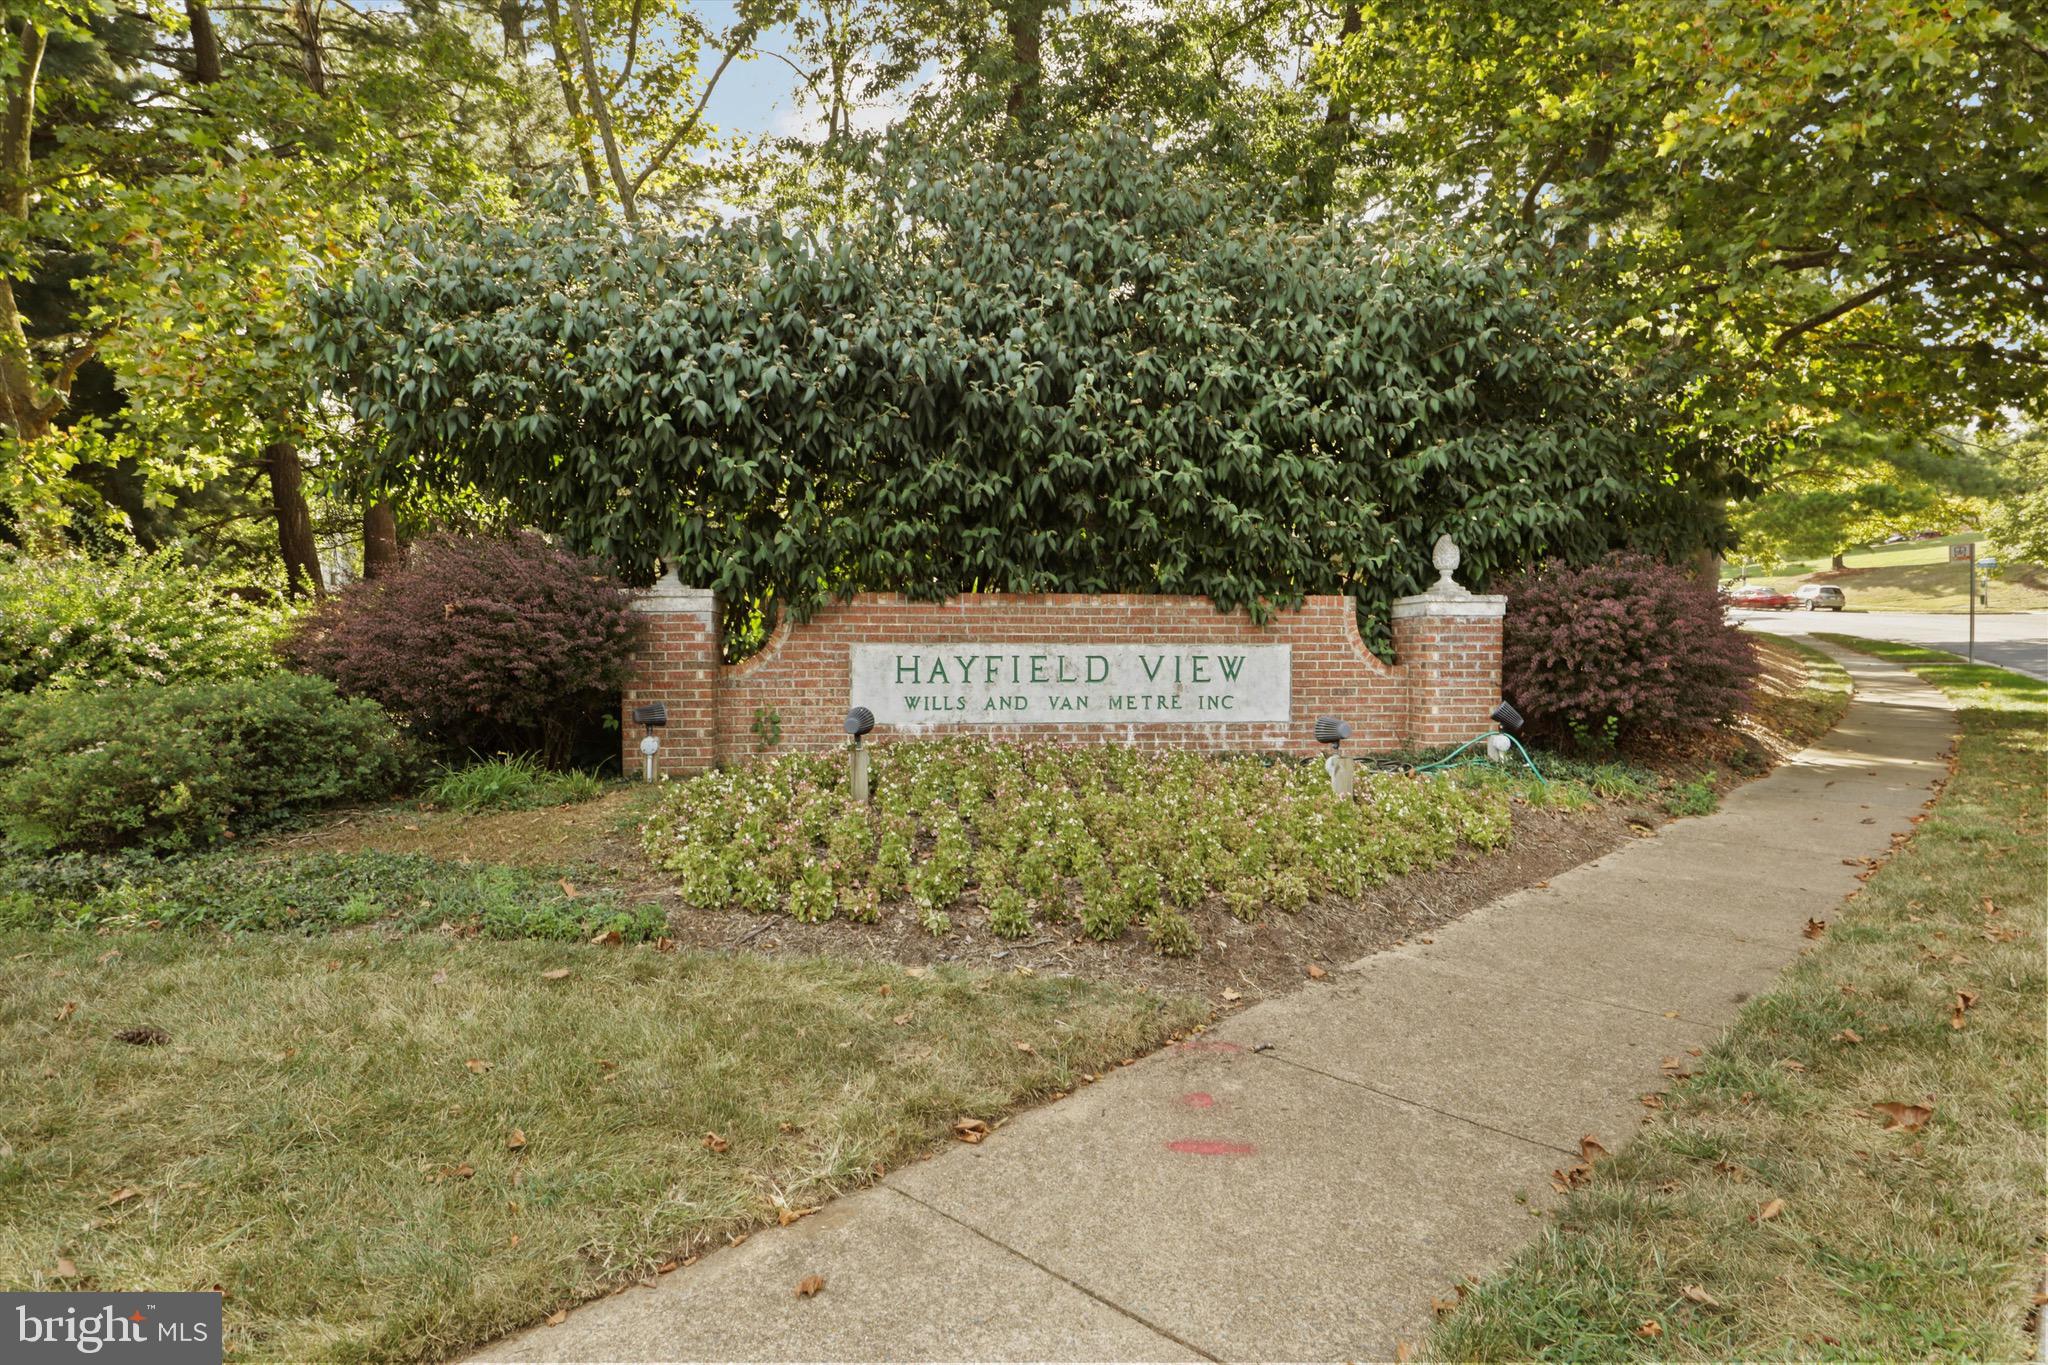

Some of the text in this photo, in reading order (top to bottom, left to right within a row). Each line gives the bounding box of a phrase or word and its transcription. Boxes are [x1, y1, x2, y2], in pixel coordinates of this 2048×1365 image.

[895, 655, 1246, 684] HAYFIELD VIEW
[905, 695, 1235, 711] WILLS AND VAN METRE INC
